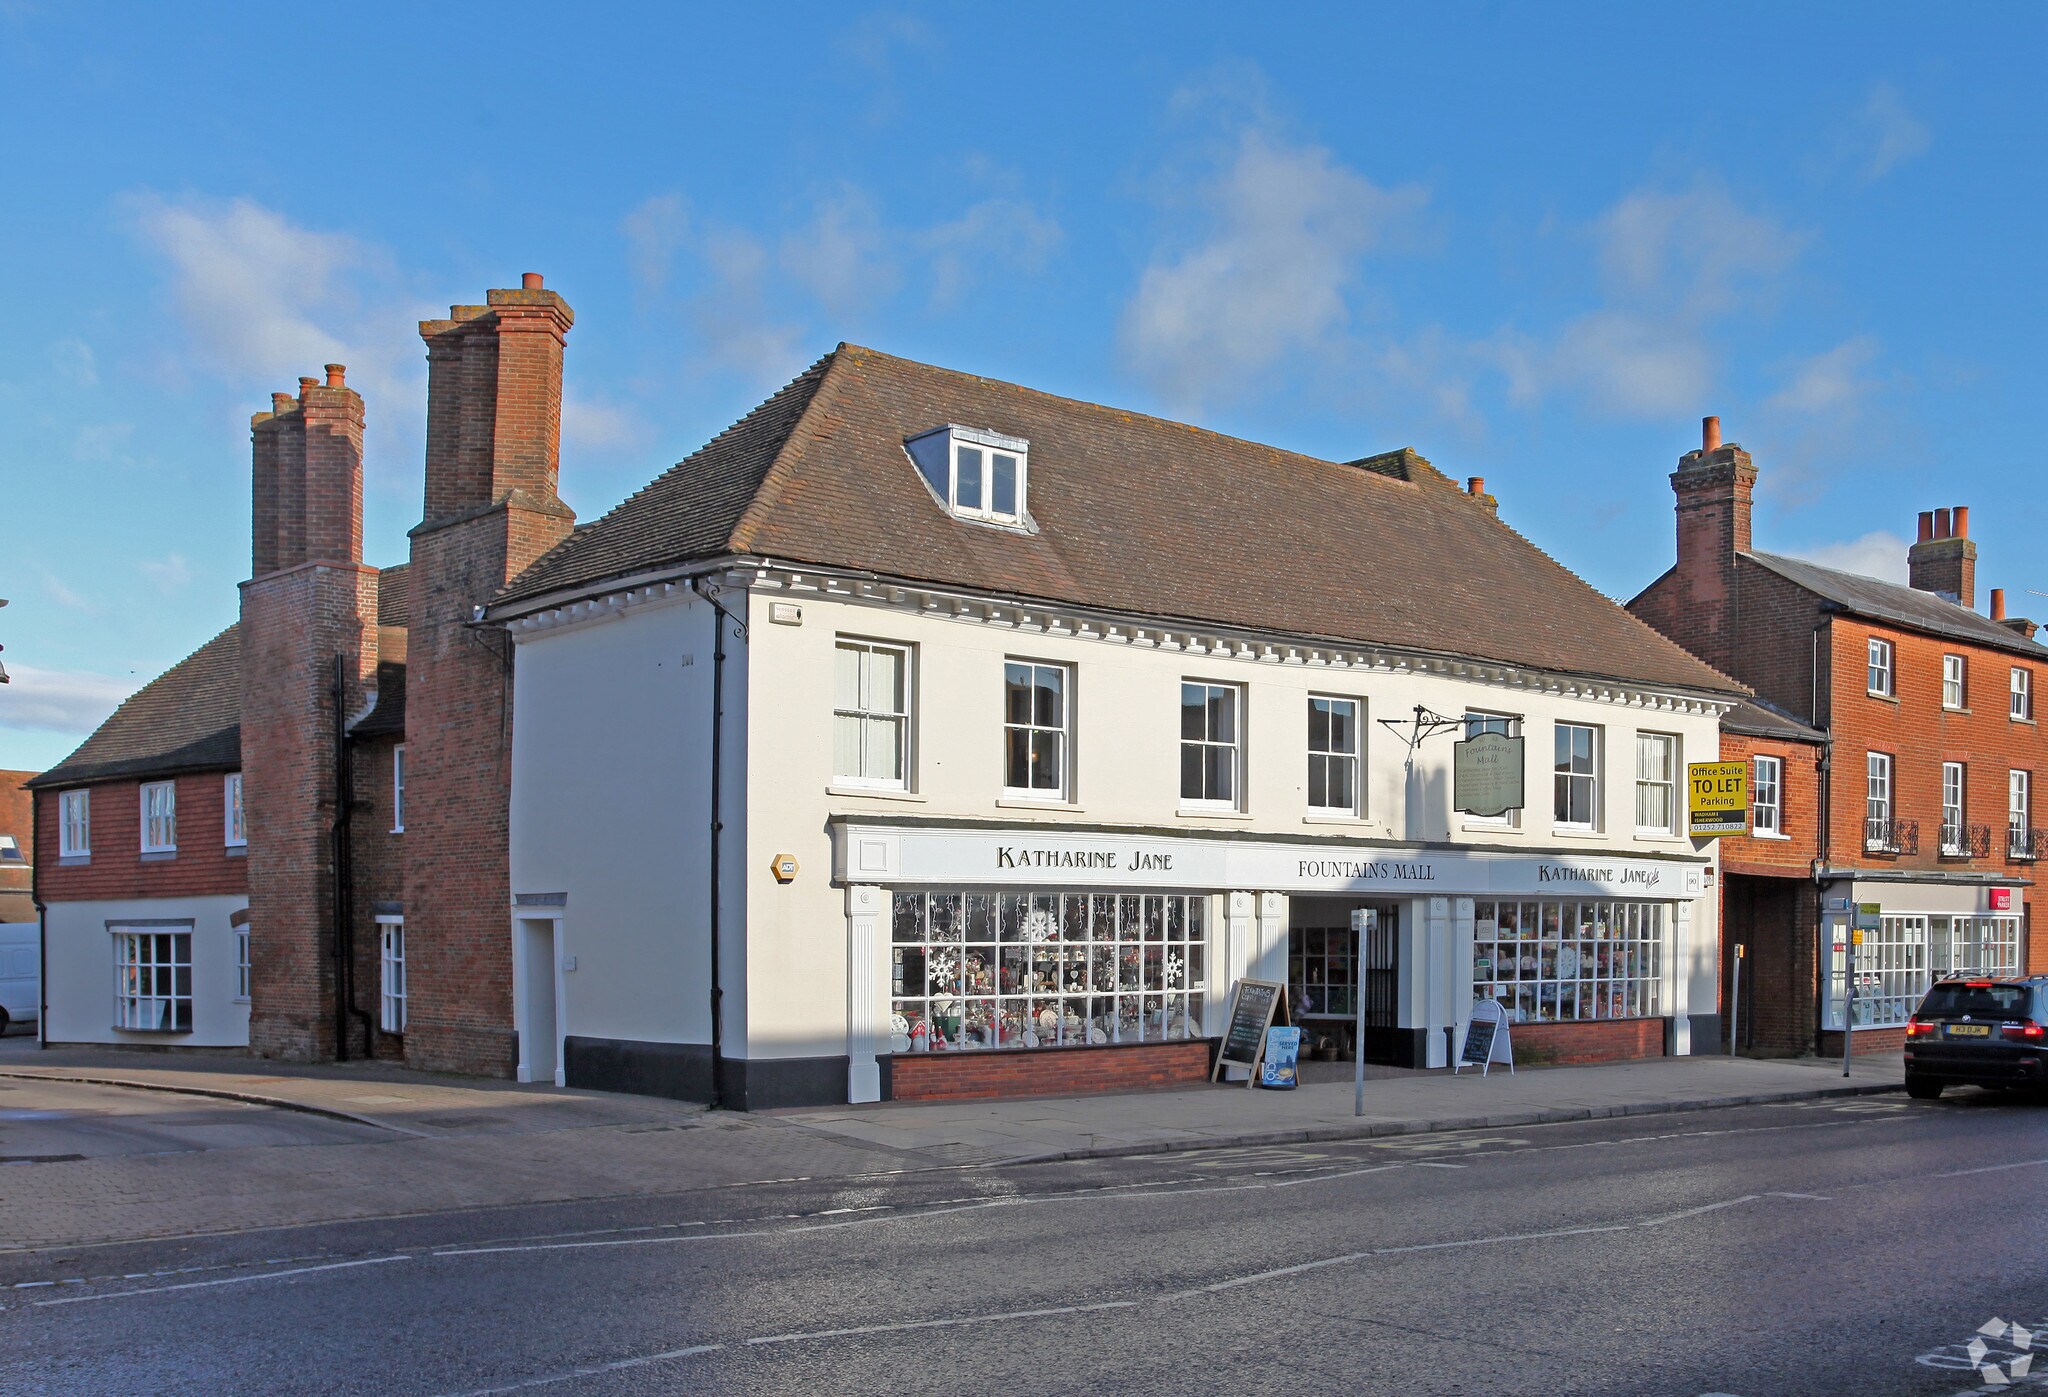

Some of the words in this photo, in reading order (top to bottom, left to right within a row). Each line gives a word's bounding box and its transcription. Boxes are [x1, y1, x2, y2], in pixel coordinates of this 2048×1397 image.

[1465, 744, 1512, 757] Fountains
[1477, 754, 1499, 764] Mall
[1692, 768, 1717, 776] Office
[1720, 766, 1742, 775] Suite
[1693, 780, 1712, 793] TO
[1717, 779, 1741, 792] LET
[1701, 797, 1734, 806] Parking
[996, 847, 1117, 868] KATHARINE
[1128, 851, 1173, 872] JANE
[782, 863, 794, 871] ADT
[1298, 861, 1388, 879] FOUNTAINS
[1393, 864, 1435, 880] MALL
[1538, 865, 1613, 882] KATHARINE
[1620, 868, 1646, 884] JANE
